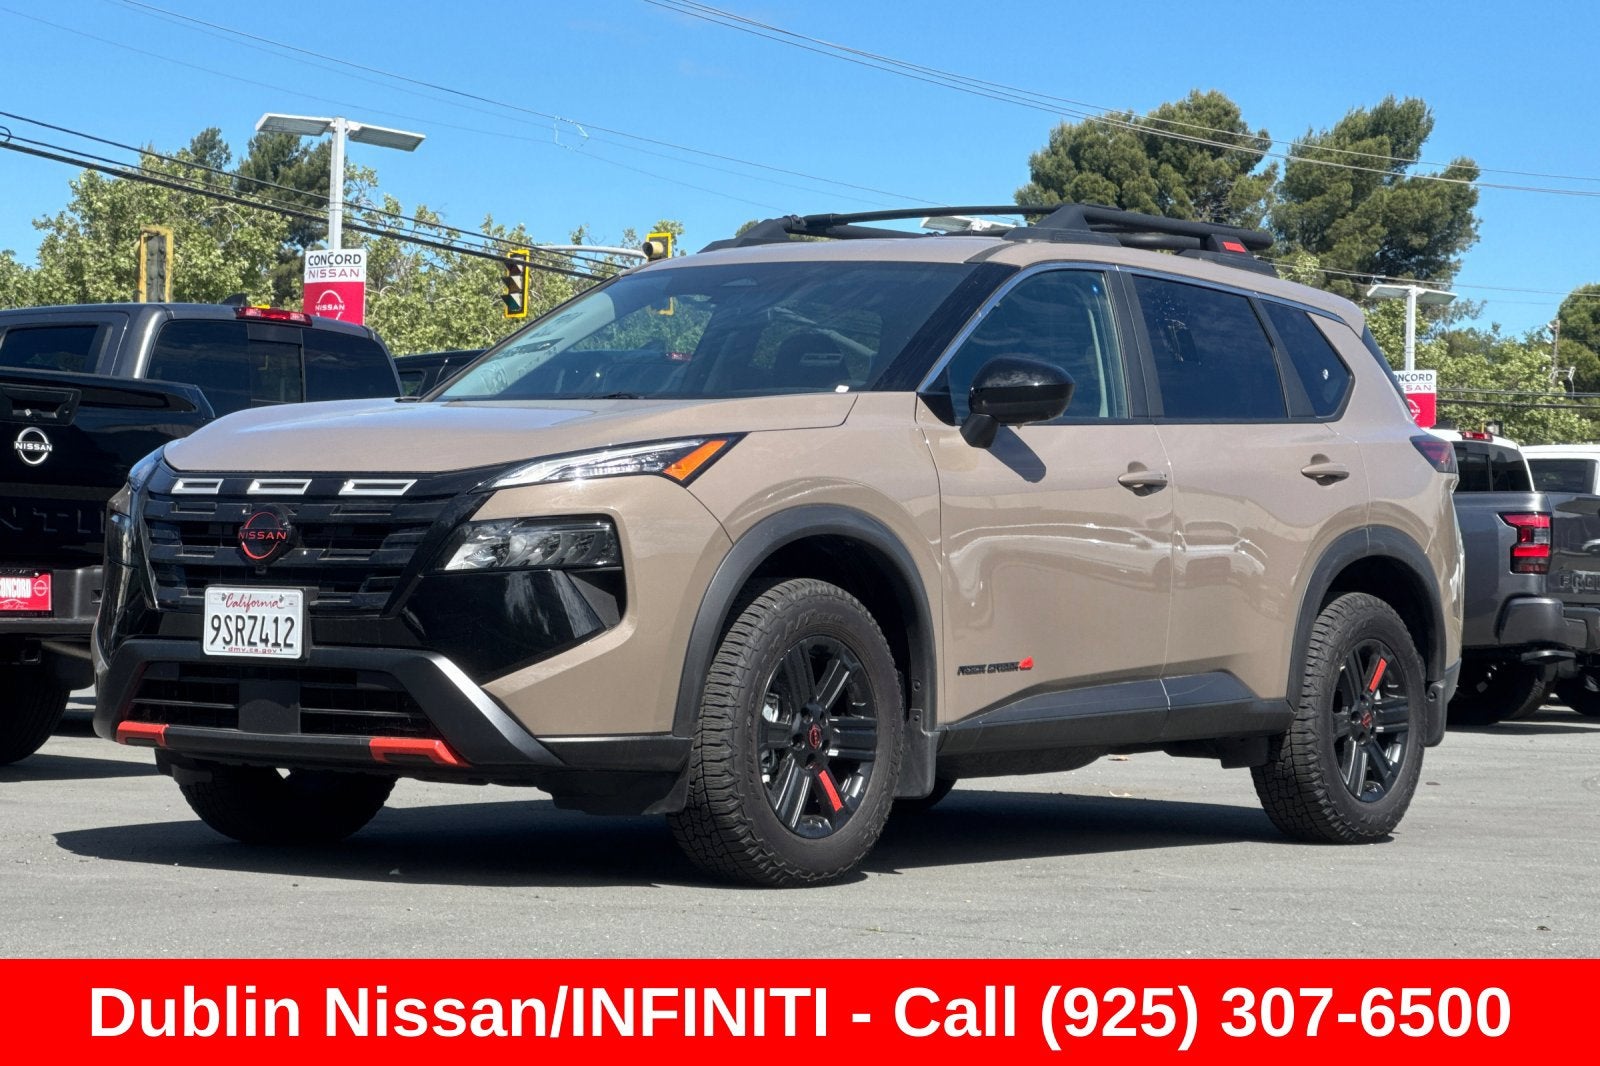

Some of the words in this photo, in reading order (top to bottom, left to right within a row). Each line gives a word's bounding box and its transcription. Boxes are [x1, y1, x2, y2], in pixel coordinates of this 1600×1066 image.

[308, 254, 362, 266] CONCORD
[308, 268, 360, 279] NISSAN
[1396, 373, 1433, 382] NCORD
[15, 442, 53, 452] NISSAN
[239, 531, 287, 540] NISSAN
[225, 593, 285, 613] California
[210, 614, 295, 648] 9SRZ412
[228, 646, 278, 655] dmv.ca.gov
